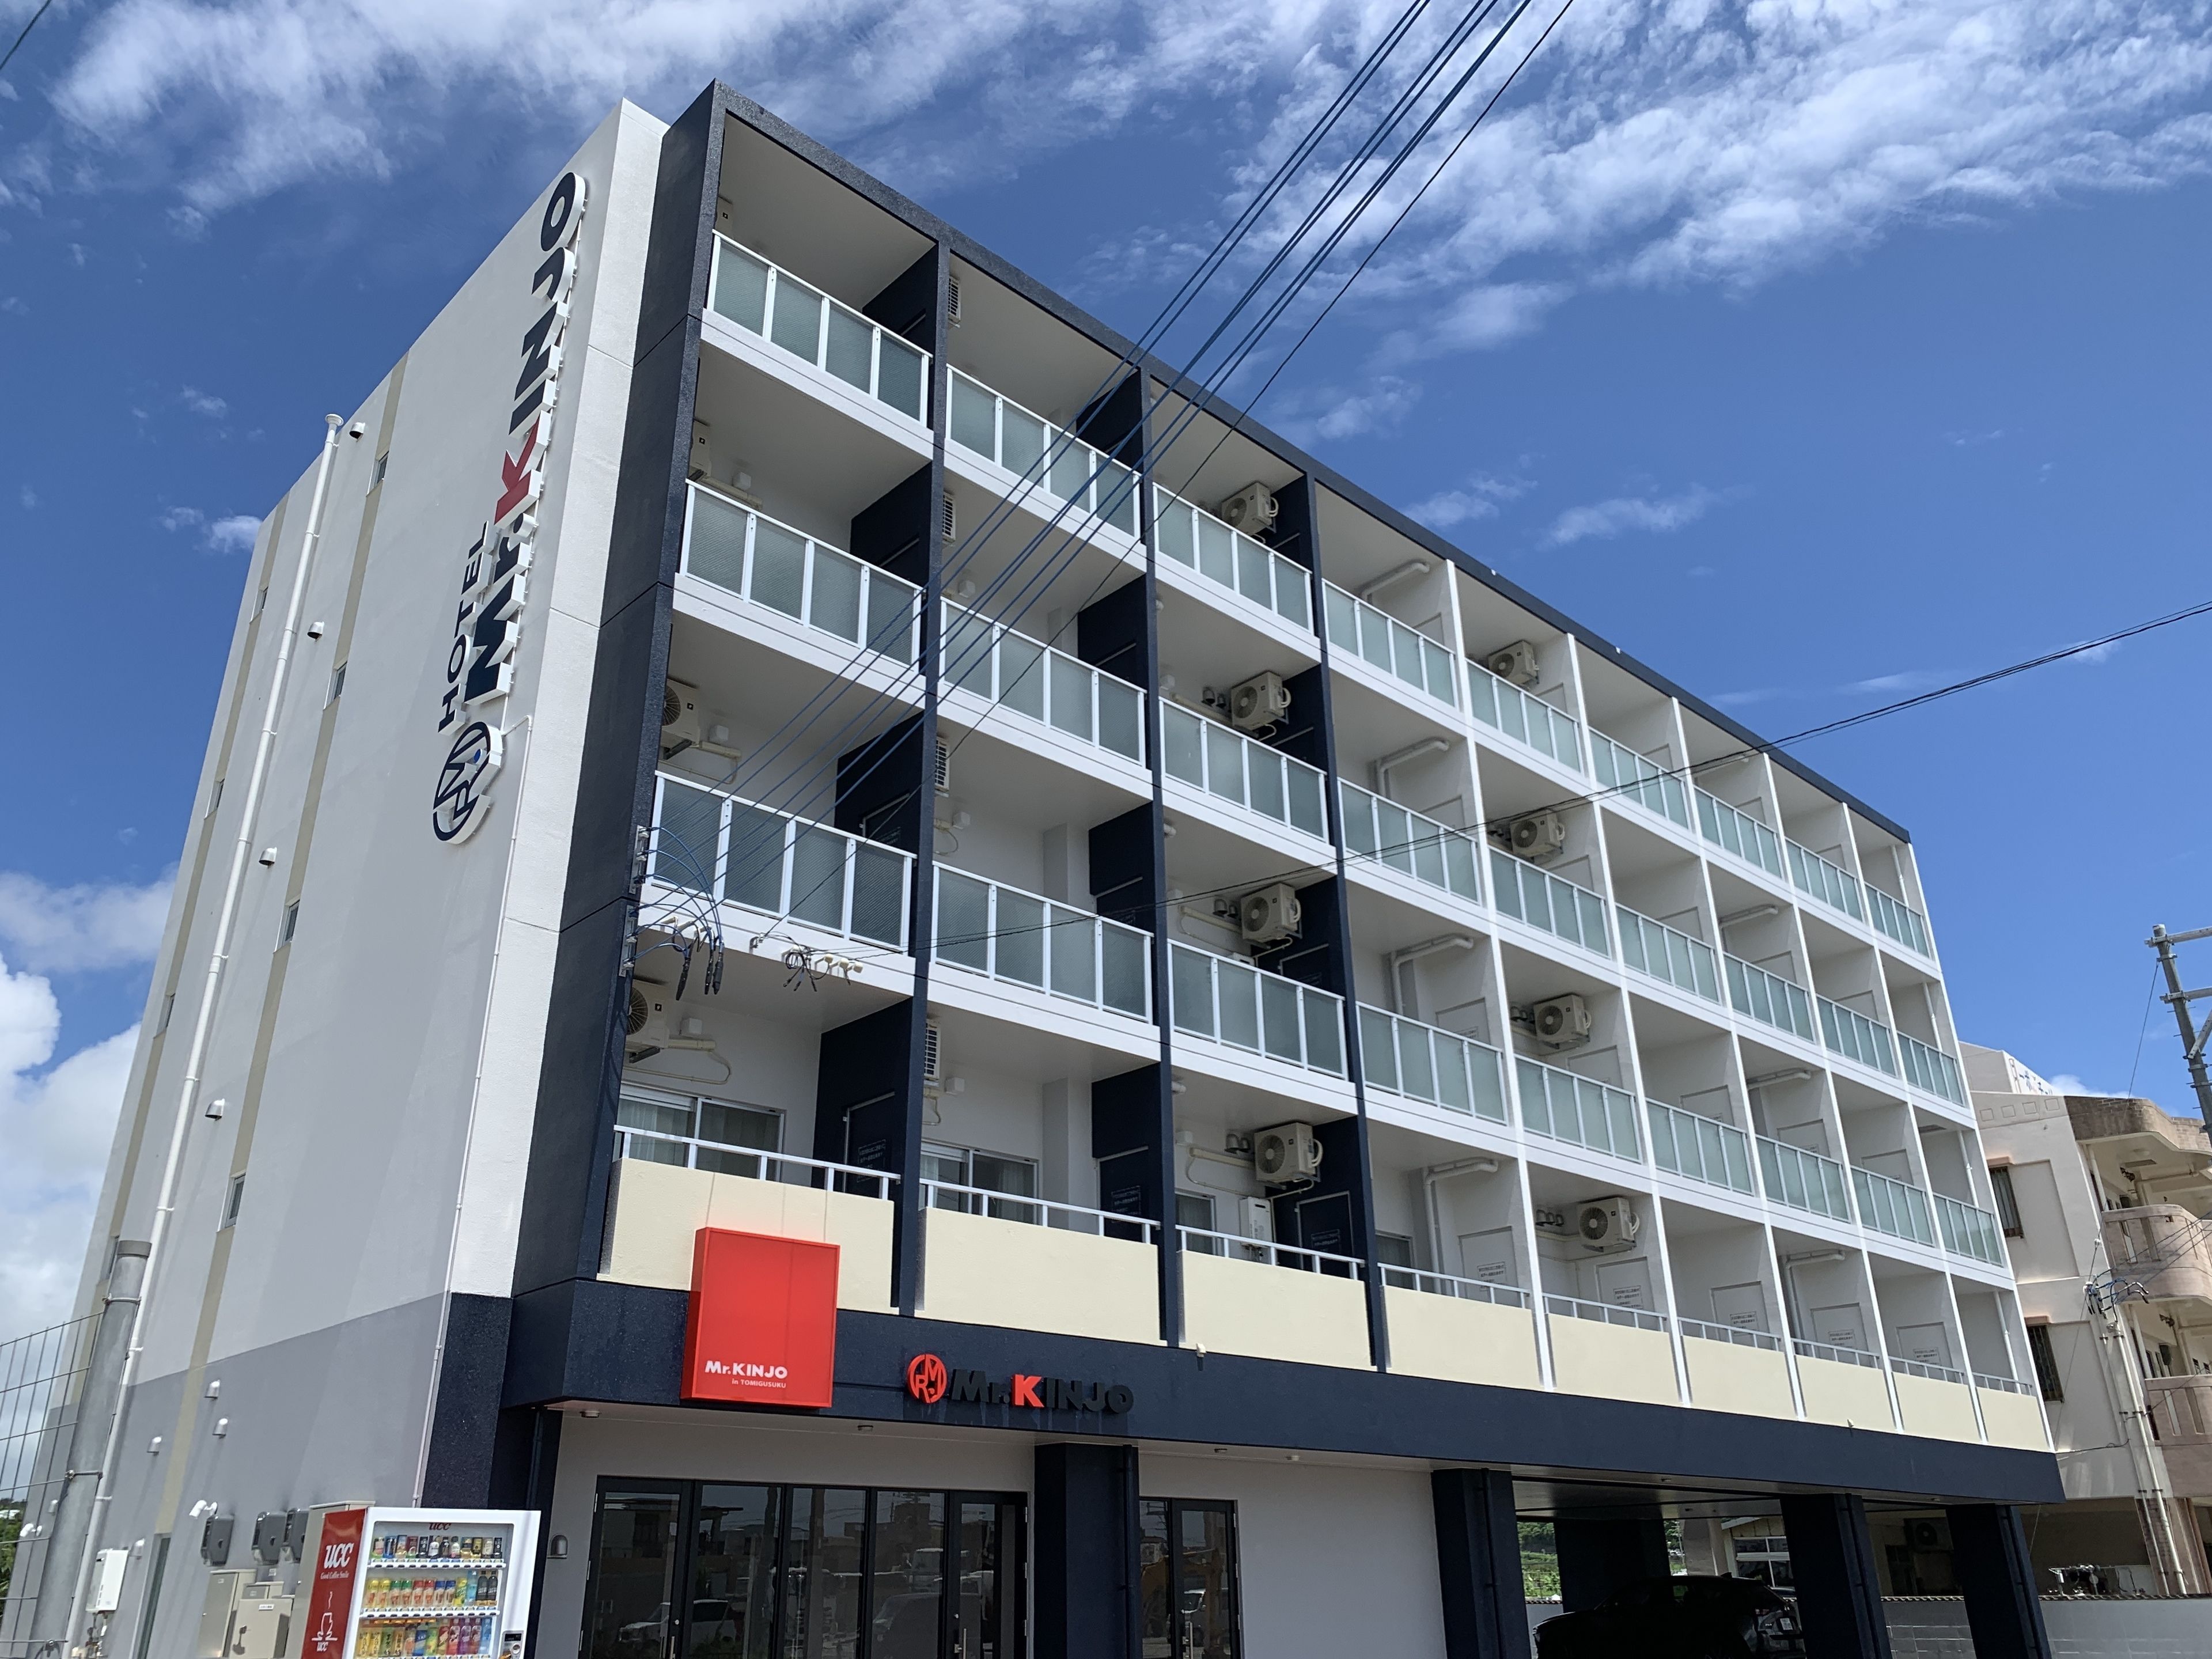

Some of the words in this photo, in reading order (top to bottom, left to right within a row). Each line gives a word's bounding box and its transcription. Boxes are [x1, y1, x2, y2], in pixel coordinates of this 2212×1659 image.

[437, 520, 495, 734] HOTEL
[704, 1360, 788, 1379] Mr.KINJO
[740, 1378, 786, 1388] TOMIGUSUKU
